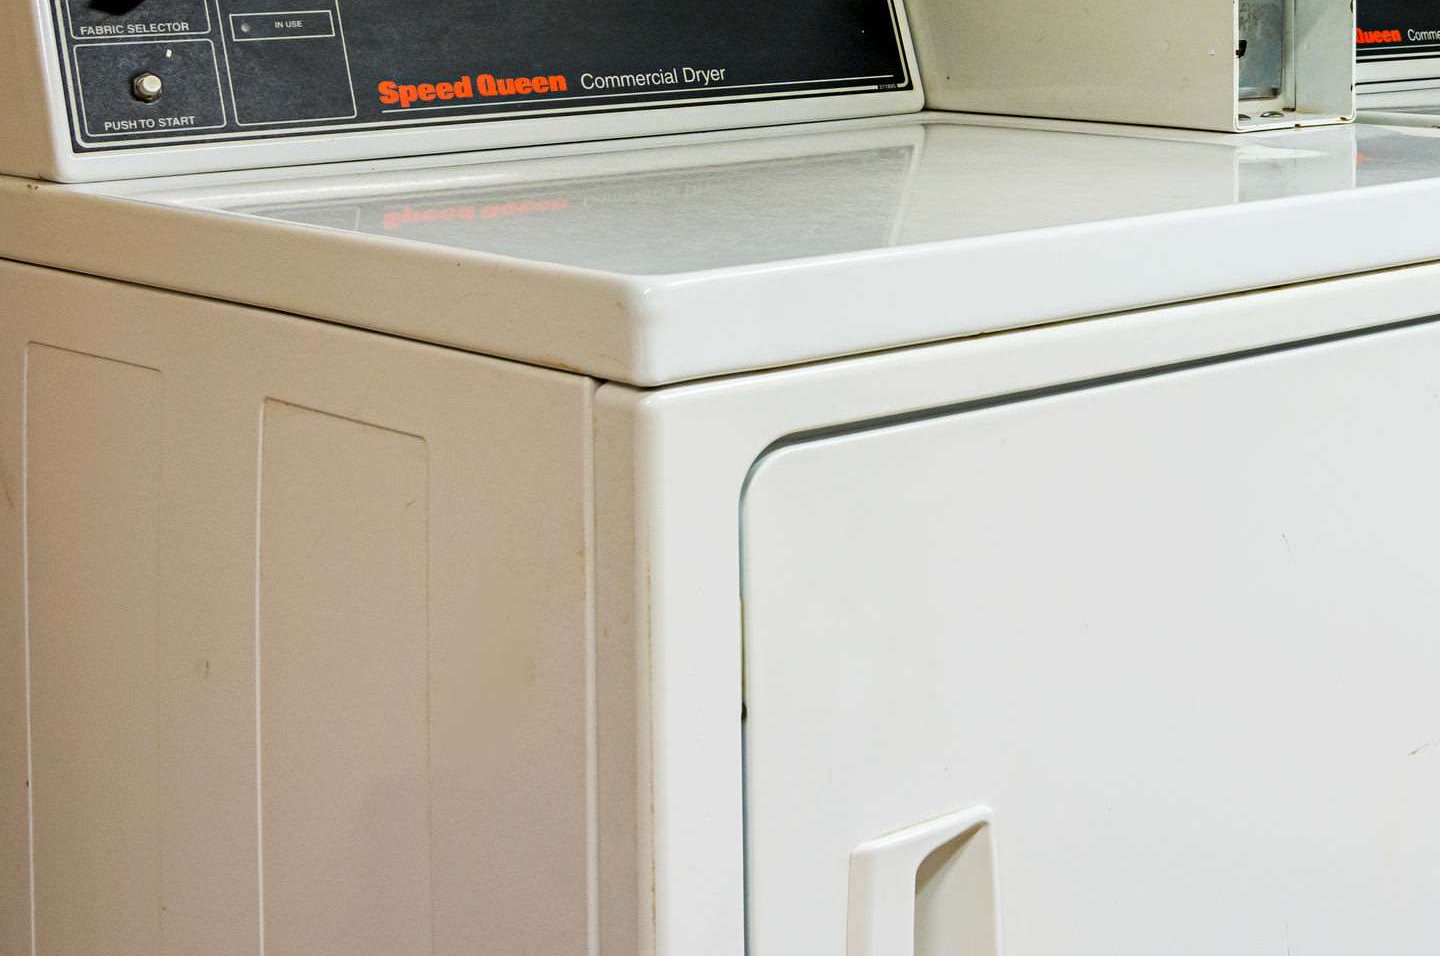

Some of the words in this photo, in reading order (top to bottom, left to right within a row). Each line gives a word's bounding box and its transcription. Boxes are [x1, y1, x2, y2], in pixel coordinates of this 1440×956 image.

[80, 25, 124, 36] FABRIC
[127, 21, 190, 34] SELECTOR
[274, 20, 285, 29] IN
[285, 20, 304, 28] USE
[378, 75, 473, 108] Speed
[476, 73, 568, 96] Queen
[580, 67, 678, 90] Commercial
[682, 66, 726, 86] Dryer
[104, 120, 137, 131] PUSH
[138, 118, 156, 129] TO
[158, 115, 196, 127] START
